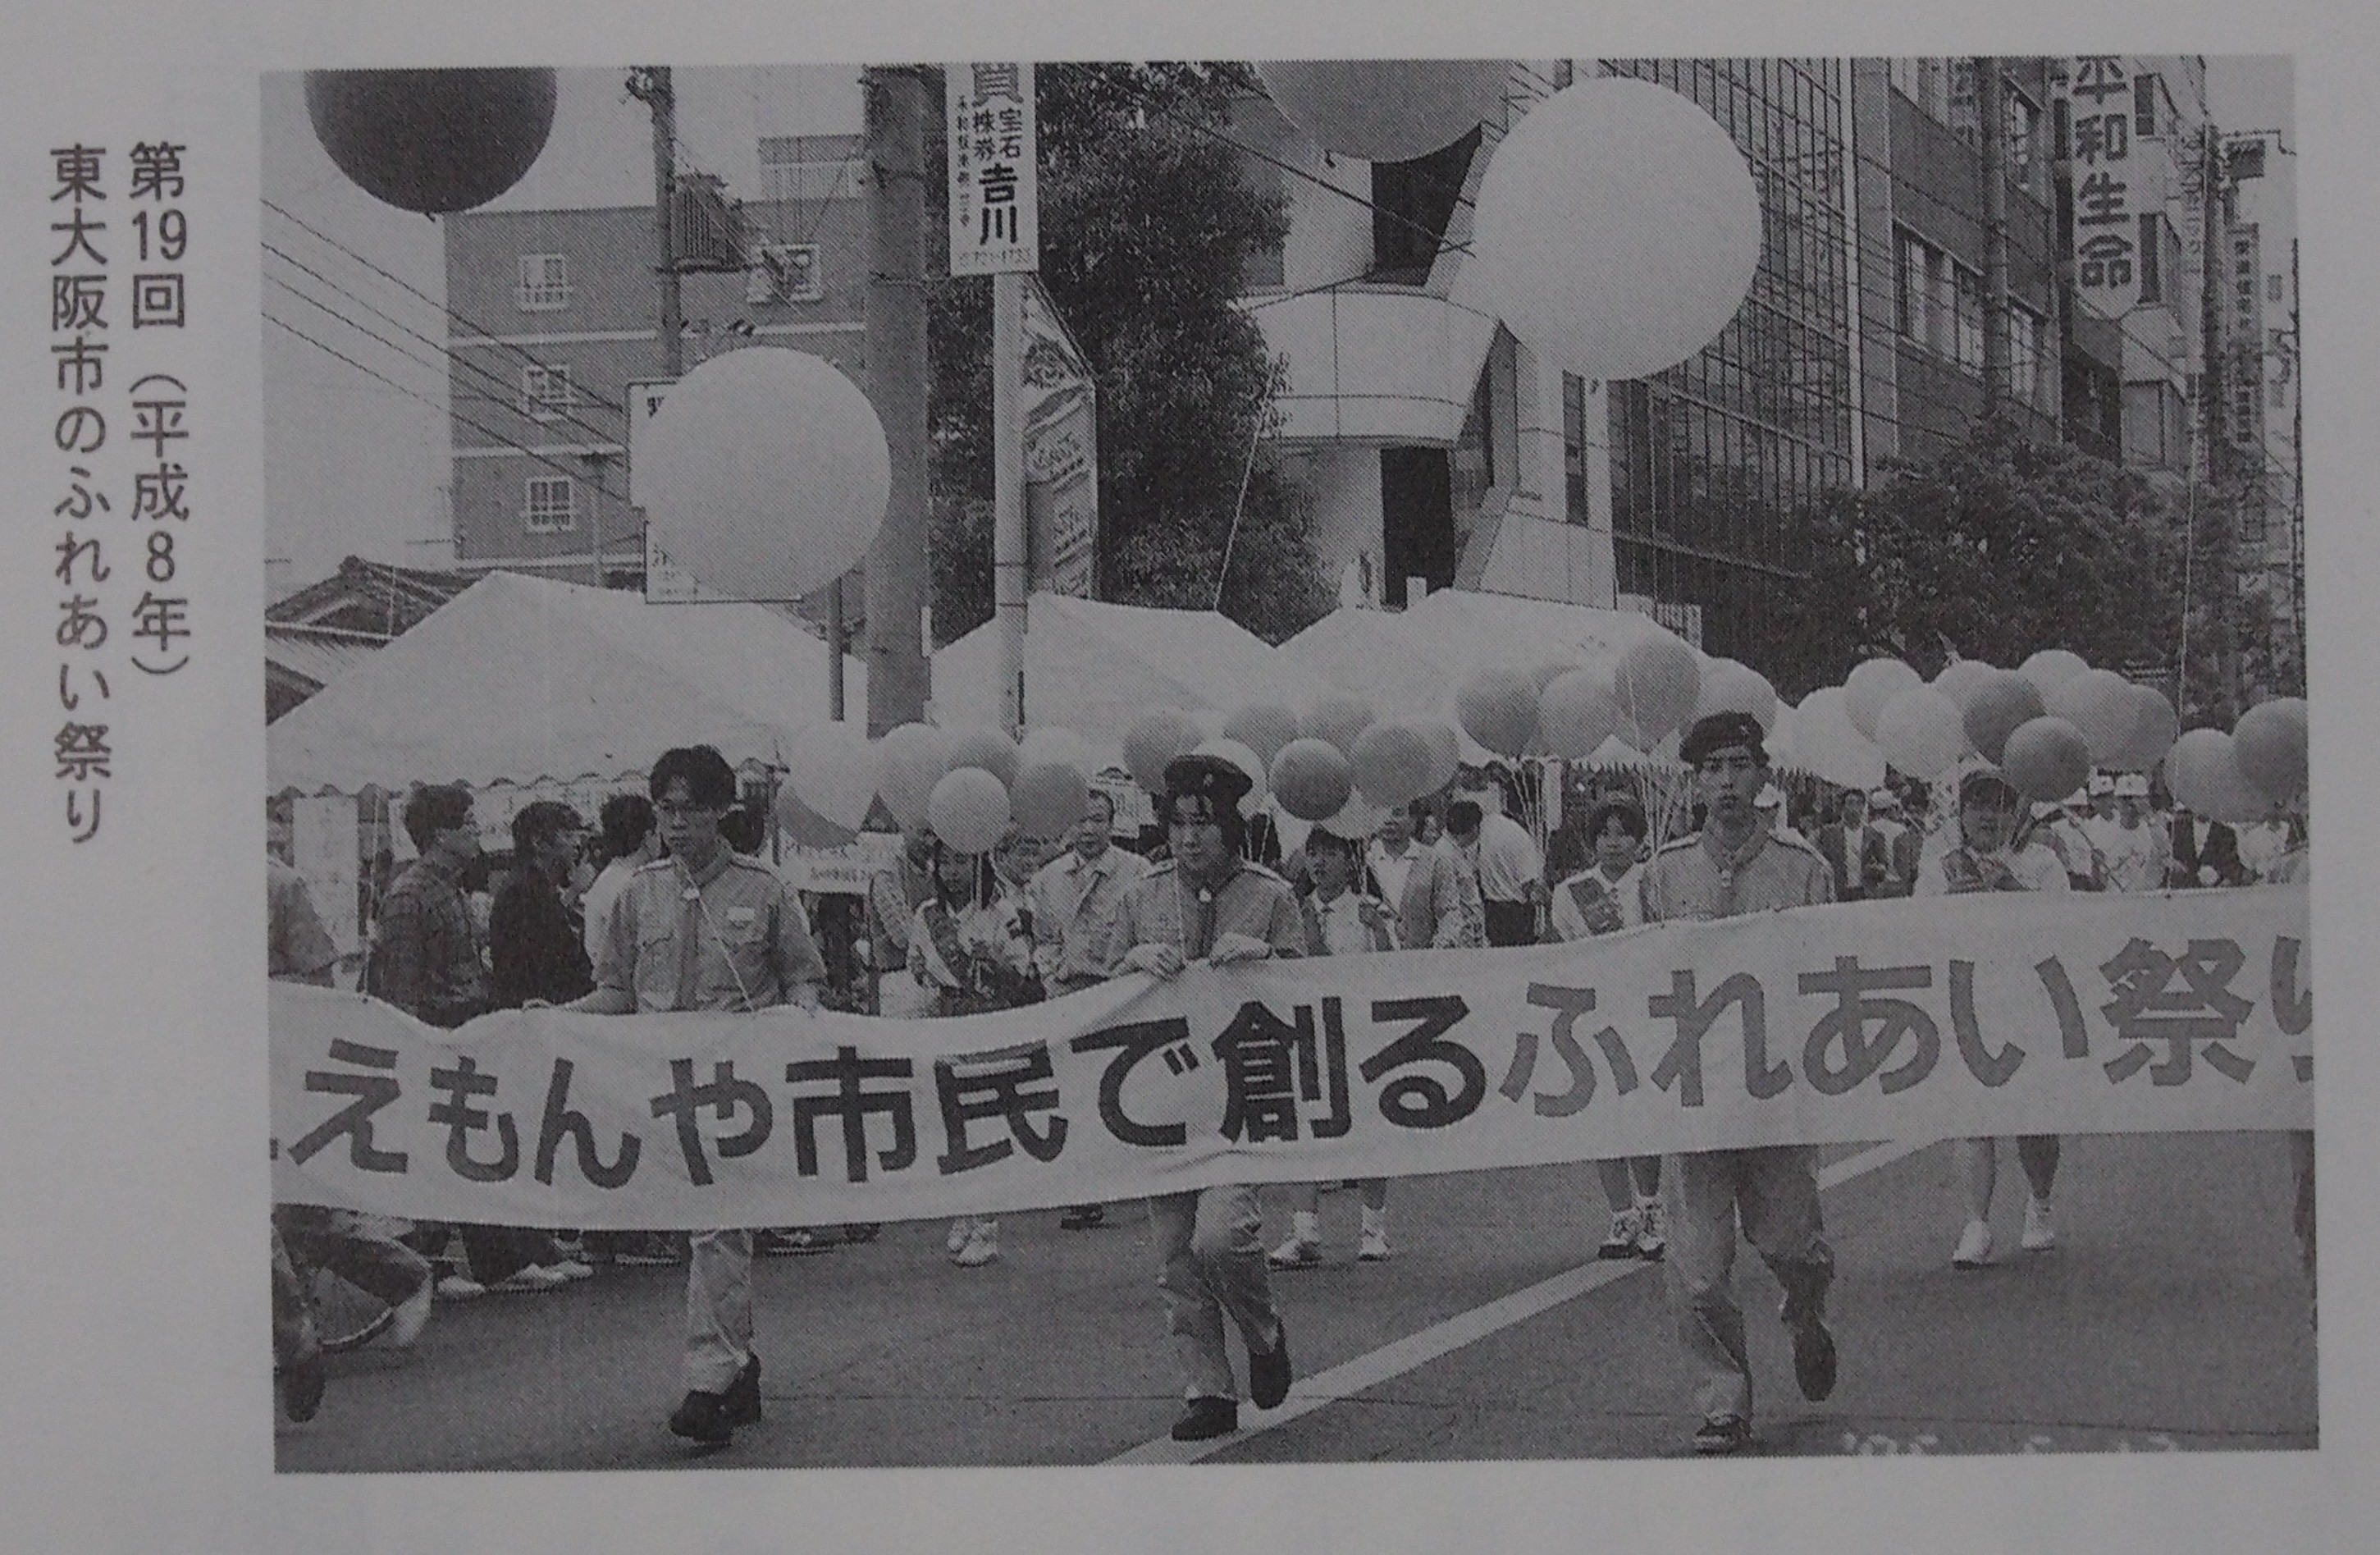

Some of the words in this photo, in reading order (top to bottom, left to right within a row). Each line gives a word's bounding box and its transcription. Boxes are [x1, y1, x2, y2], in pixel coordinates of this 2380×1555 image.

[979, 163, 1017, 245] 吉川
[999, 107, 1023, 158] 宝石
[2072, 56, 2133, 290] 平和生命
[50, 143, 112, 845] 東大阪市のふれあい祭り
[269, 934, 2313, 1187] えもんや市民で創るふれあい祭
